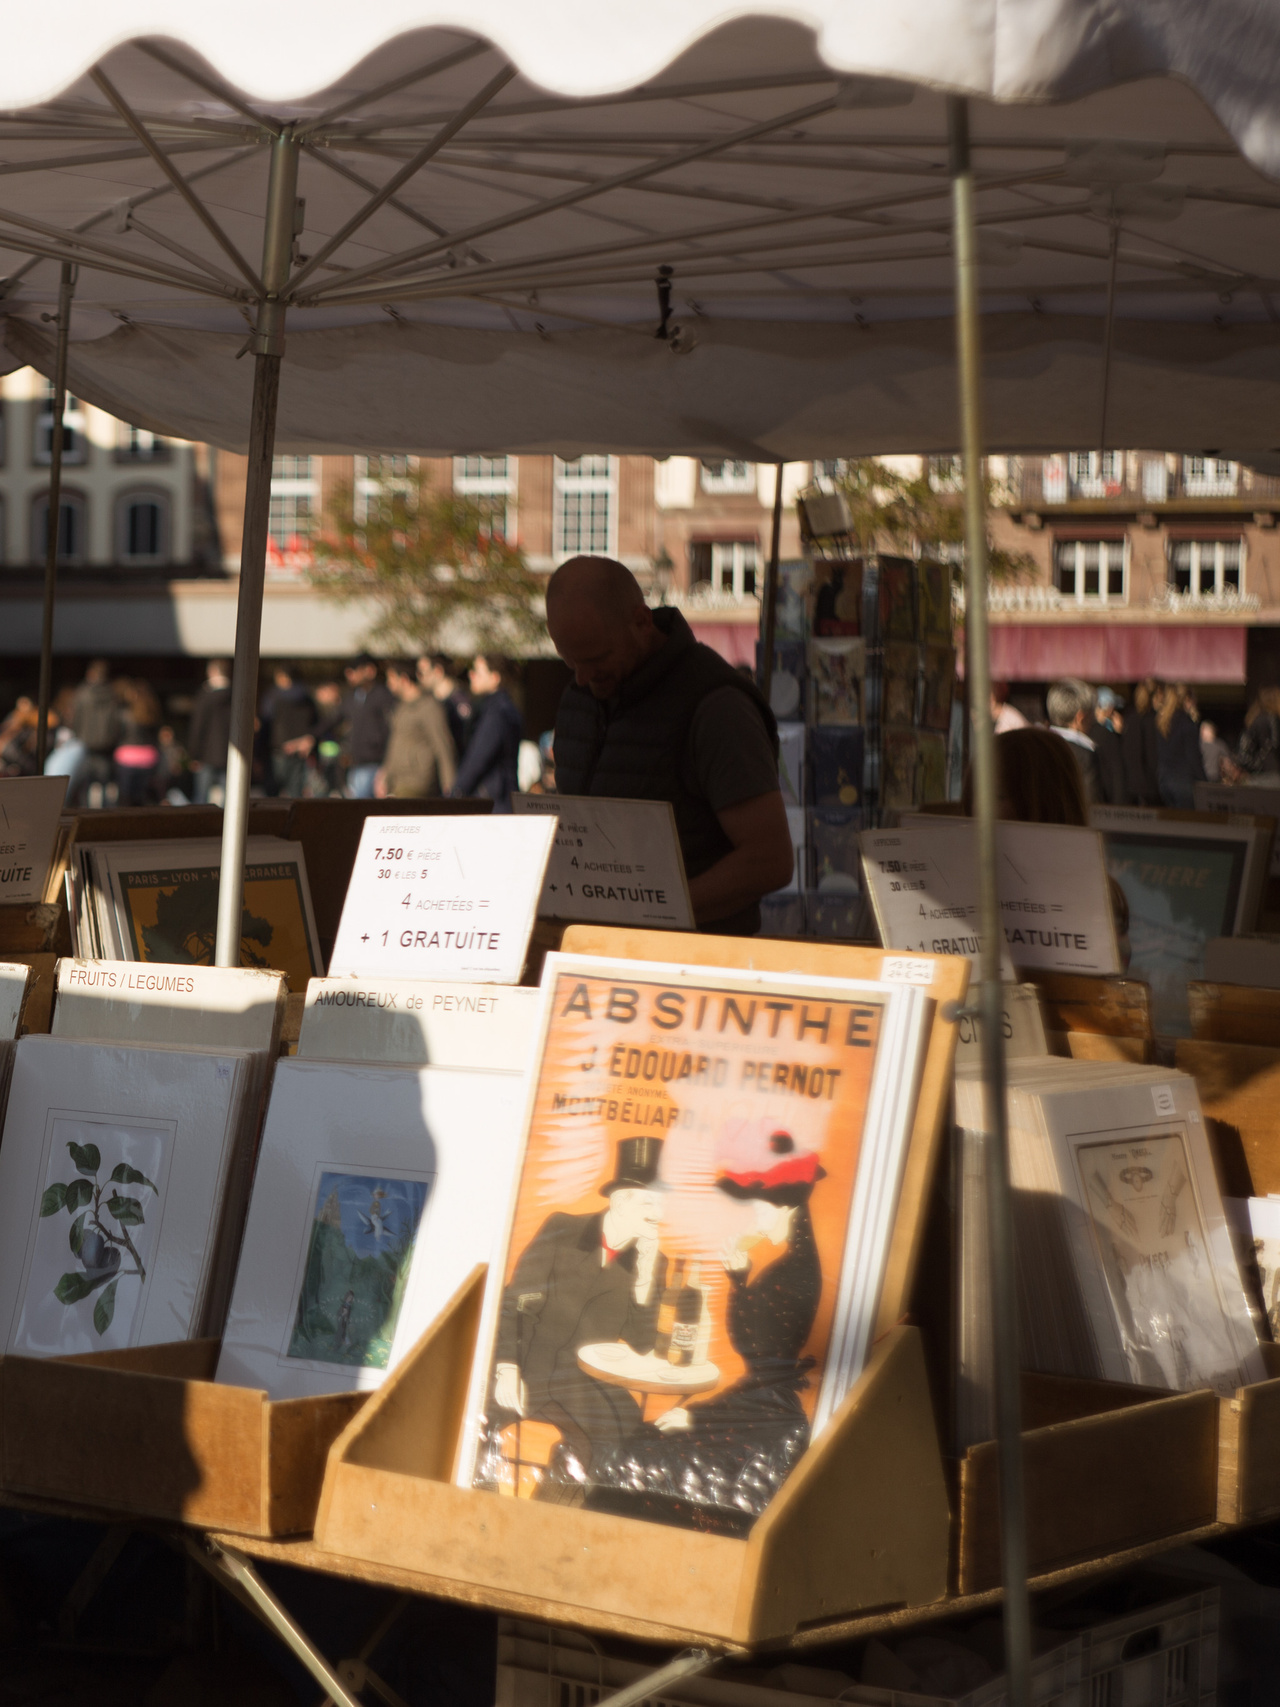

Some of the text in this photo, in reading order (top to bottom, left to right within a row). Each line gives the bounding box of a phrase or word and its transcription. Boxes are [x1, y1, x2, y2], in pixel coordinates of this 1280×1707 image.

[526, 801, 561, 811] AFFICHES
[379, 824, 421, 834] AFFICHES
[576, 838, 583, 848] 5
[374, 848, 403, 860] 7.50
[406, 849, 414, 860] €
[570, 856, 579, 870] 4
[584, 860, 632, 874] ACHETÉES
[879, 860, 901, 873] 7.50
[128, 873, 159, 885] PARIS
[171, 872, 199, 884] LYON
[377, 869, 392, 879] 30
[401, 871, 417, 880] LES
[420, 869, 428, 879] 5
[1139, 862, 1213, 888] THERE
[566, 883, 573, 896] 1
[581, 883, 667, 904] GRATUITE
[890, 881, 901, 892] 30
[401, 893, 412, 910] 4
[415, 896, 474, 911] ACHETÉES
[1000, 898, 1047, 914] HETÉES
[919, 903, 927, 920] 4
[929, 903, 967, 919] ACHETÉES
[360, 927, 501, 950] + 1 GRATUITE
[69, 968, 117, 988] FRUITS
[128, 972, 195, 993] LEGUMES
[314, 990, 499, 1014] AMOUREUX de PEYNET
[560, 982, 875, 1049] ABSINTHE
[608, 1042, 729, 1090] ÉDOUARD
[740, 1060, 842, 1101] PERNOT
[627, 1085, 669, 1100] ANONYME
[552, 1092, 695, 1132] MONTBÉLIARD
